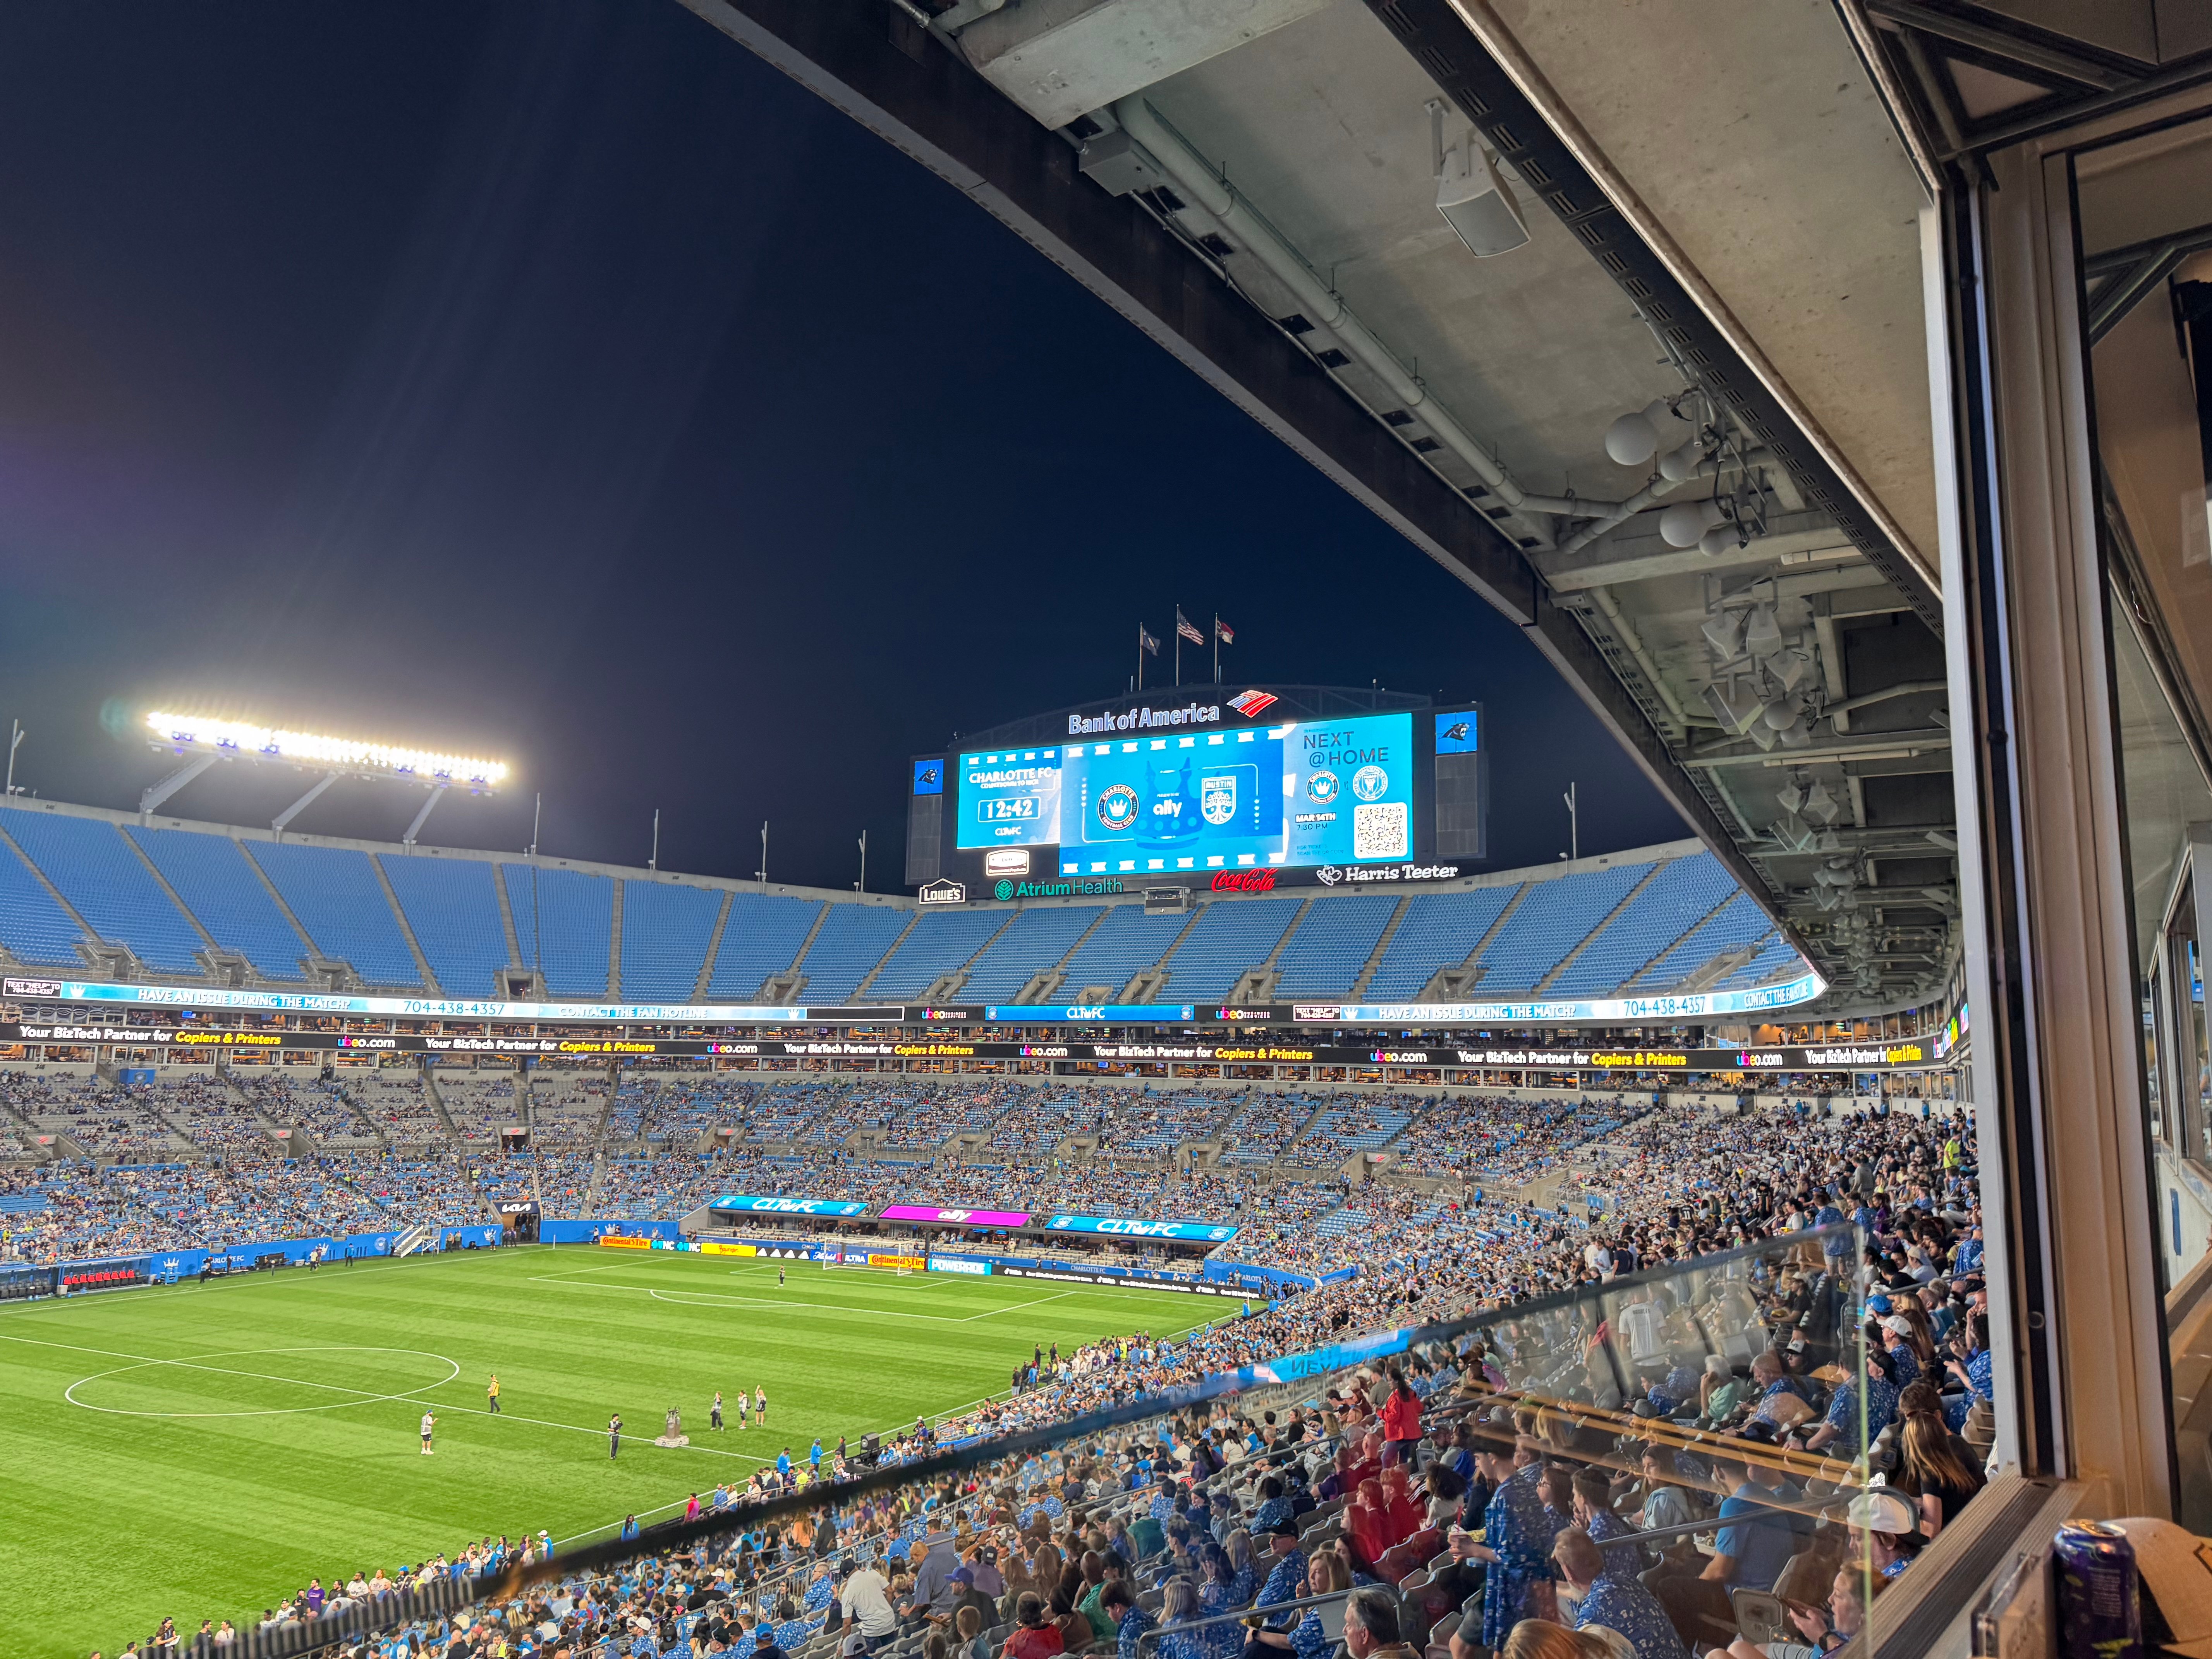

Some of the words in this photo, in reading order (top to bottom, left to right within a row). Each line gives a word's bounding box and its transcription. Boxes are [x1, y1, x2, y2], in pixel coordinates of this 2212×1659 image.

[1068, 711, 1116, 734] Bank
[1117, 709, 1138, 729] of
[1138, 703, 1219, 728] America
[1304, 731, 1354, 749] NEXT
[1309, 747, 1389, 768] @HOME
[969, 768, 1036, 783] CHARLOTTE
[1038, 767, 1052, 778] FC
[1206, 780, 1232, 788] AUSTIN
[1102, 786, 1134, 800] CHARLOTTE
[987, 799, 1032, 819] 12:42
[1153, 799, 1183, 817] ally
[1296, 814, 1315, 823] MAR
[1316, 812, 1336, 821] 14TH
[1212, 867, 1278, 892] Coca-Cola
[1345, 866, 1399, 881] Harris
[1402, 864, 1458, 879] Teeter
[924, 887, 961, 901] LOWE'S
[1016, 881, 1070, 896] Atrium
[1073, 878, 1122, 895] Health
[138, 989, 172, 1001] HAVE
[173, 991, 194, 1003] AN
[196, 992, 229, 1005] ISSUE
[232, 994, 278, 1006] DURING
[278, 996, 303, 1008] THE
[304, 997, 350, 1009] MATCH?
[1624, 996, 1706, 1016] 704-438-4357
[1744, 990, 1774, 1008] CONTACT
[404, 1001, 505, 1015] 704-438-4357
[558, 1006, 611, 1017] CONTACT
[611, 1007, 636, 1018] THE
[637, 1007, 658, 1018] FAN
[661, 1007, 707, 1018] HOTLINE
[922, 1007, 945, 1020] ubeo
[1216, 1006, 1244, 1020] ubeo
[1379, 1008, 1410, 1019] HAVE
[1411, 1007, 1431, 1019] AN
[1432, 1007, 1462, 1018] ISSUE
[1464, 1006, 1509, 1018] DURING
[1510, 1006, 1533, 1018] THE
[1534, 1005, 1576, 1017] MATCH?
[19, 1026, 51, 1038] Your
[53, 1027, 101, 1039] BizTech
[104, 1029, 151, 1041] Partner
[153, 1029, 172, 1042] for
[175, 1031, 221, 1045] Copiers
[223, 1033, 233, 1044] &
[235, 1033, 281, 1044] Printers
[337, 1036, 395, 1048] ubeo.com
[426, 1038, 451, 1049] Your
[453, 1039, 495, 1049] BizTech
[496, 1040, 538, 1050] Partner
[539, 1041, 557, 1051] for
[559, 1041, 600, 1053] Copiers
[602, 1042, 612, 1052] &
[614, 1042, 655, 1052] Printers
[707, 1042, 758, 1054] ubeo.com
[784, 1044, 807, 1053] Your
[808, 1044, 842, 1054] BizTech
[843, 1044, 878, 1054] Partner
[879, 1044, 893, 1054] for
[894, 1044, 927, 1056] Copiers
[928, 1045, 936, 1054] &
[938, 1045, 974, 1054] Printers
[1019, 1044, 1068, 1056] ubeo.com
[1093, 1046, 1117, 1057] Your
[1118, 1046, 1155, 1057] BizTech
[1157, 1047, 1195, 1057] Partner
[1196, 1047, 1212, 1057] for
[1215, 1048, 1255, 1061] Copiers
[1257, 1048, 1266, 1059] &
[1269, 1049, 1313, 1060] Printers
[1370, 1049, 1427, 1063] ubeo.com
[1457, 1051, 1484, 1063] Your
[1486, 1051, 1527, 1063] BizTech
[1528, 1051, 1571, 1064] Partner
[1573, 1052, 1590, 1064] for
[1591, 1053, 1633, 1068] Copiers
[1634, 1053, 1644, 1065] &
[1646, 1053, 1686, 1066] Printers
[1736, 1051, 1783, 1066] ubeo.com
[1805, 1049, 1826, 1064] Your
[1826, 1048, 1852, 1063] BizTech
[1852, 1048, 1879, 1063] Partner
[938, 1210, 973, 1223] ally
[603, 1237, 631, 1245] Continental
[663, 1241, 675, 1250] NC
[689, 1242, 701, 1252] NC
[932, 1261, 985, 1274] POWERADE
